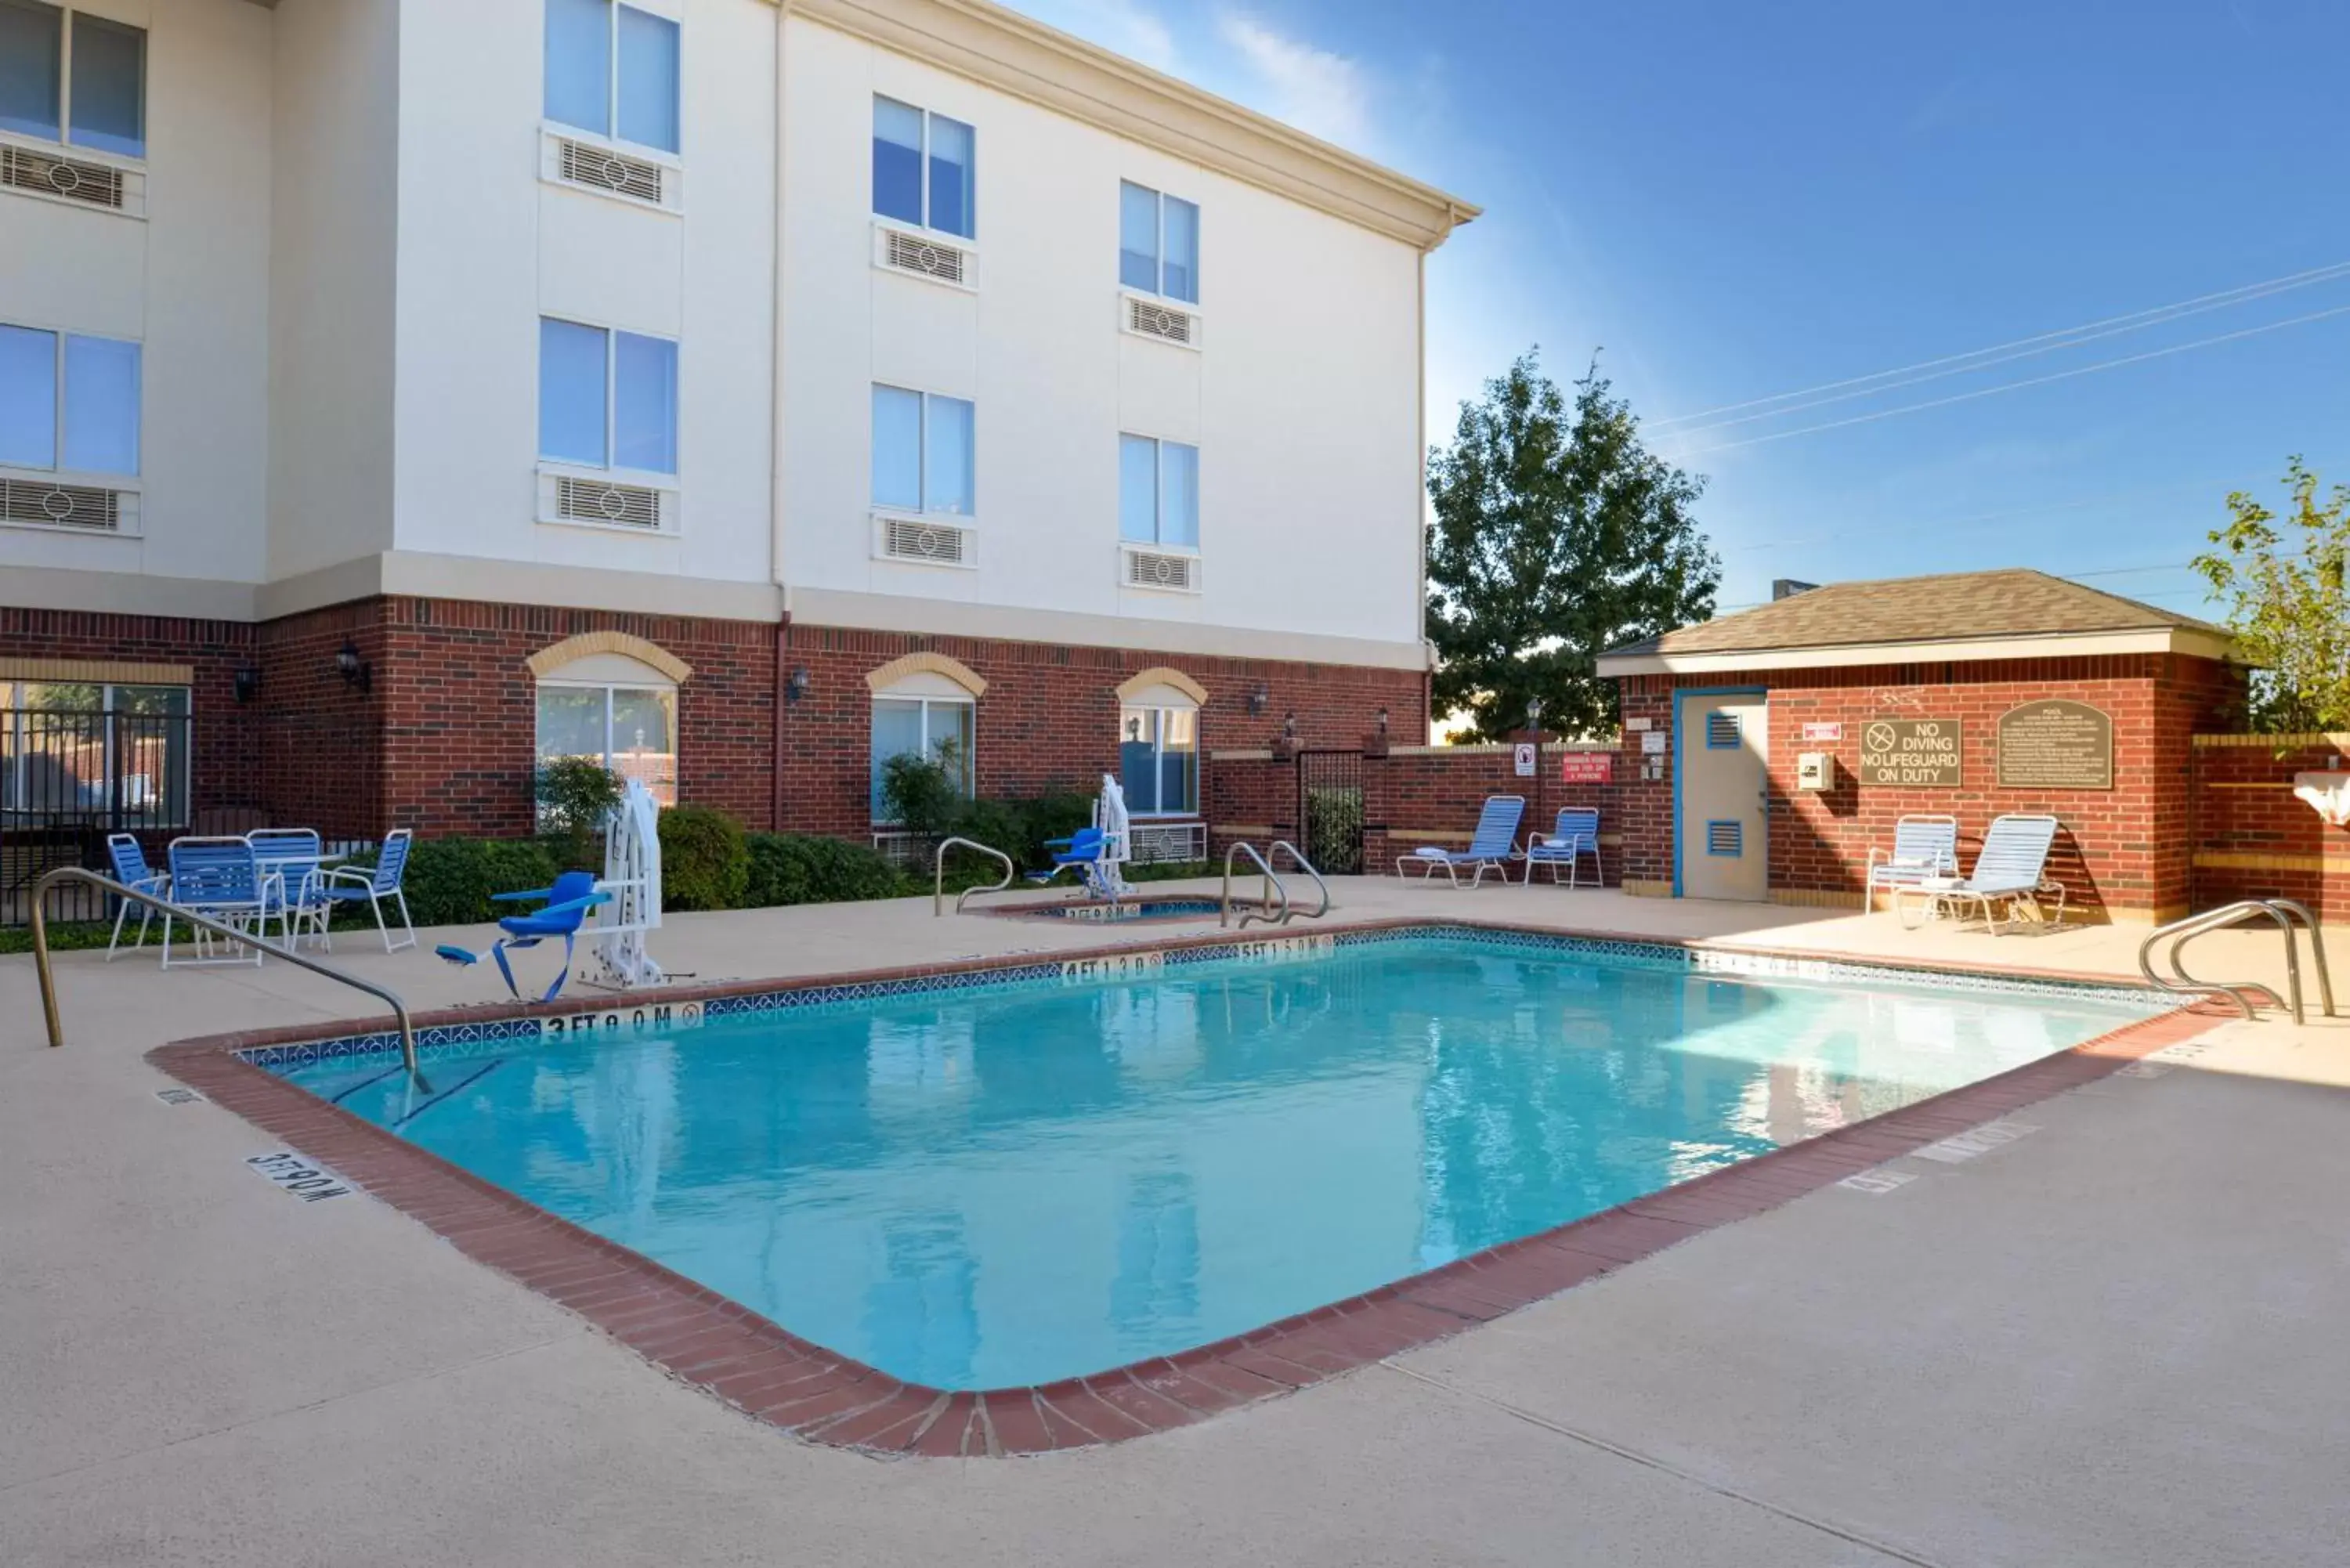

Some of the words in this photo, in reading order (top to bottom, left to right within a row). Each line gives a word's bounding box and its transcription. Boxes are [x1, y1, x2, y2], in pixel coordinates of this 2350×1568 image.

[1915, 723, 1939, 737] NO
[1903, 737, 1953, 751] DIVING
[1861, 753, 1881, 767] NO
[1882, 753, 1958, 767] LIFEGUARD
[1878, 768, 1898, 782] ON
[1903, 768, 1940, 782] DUTY
